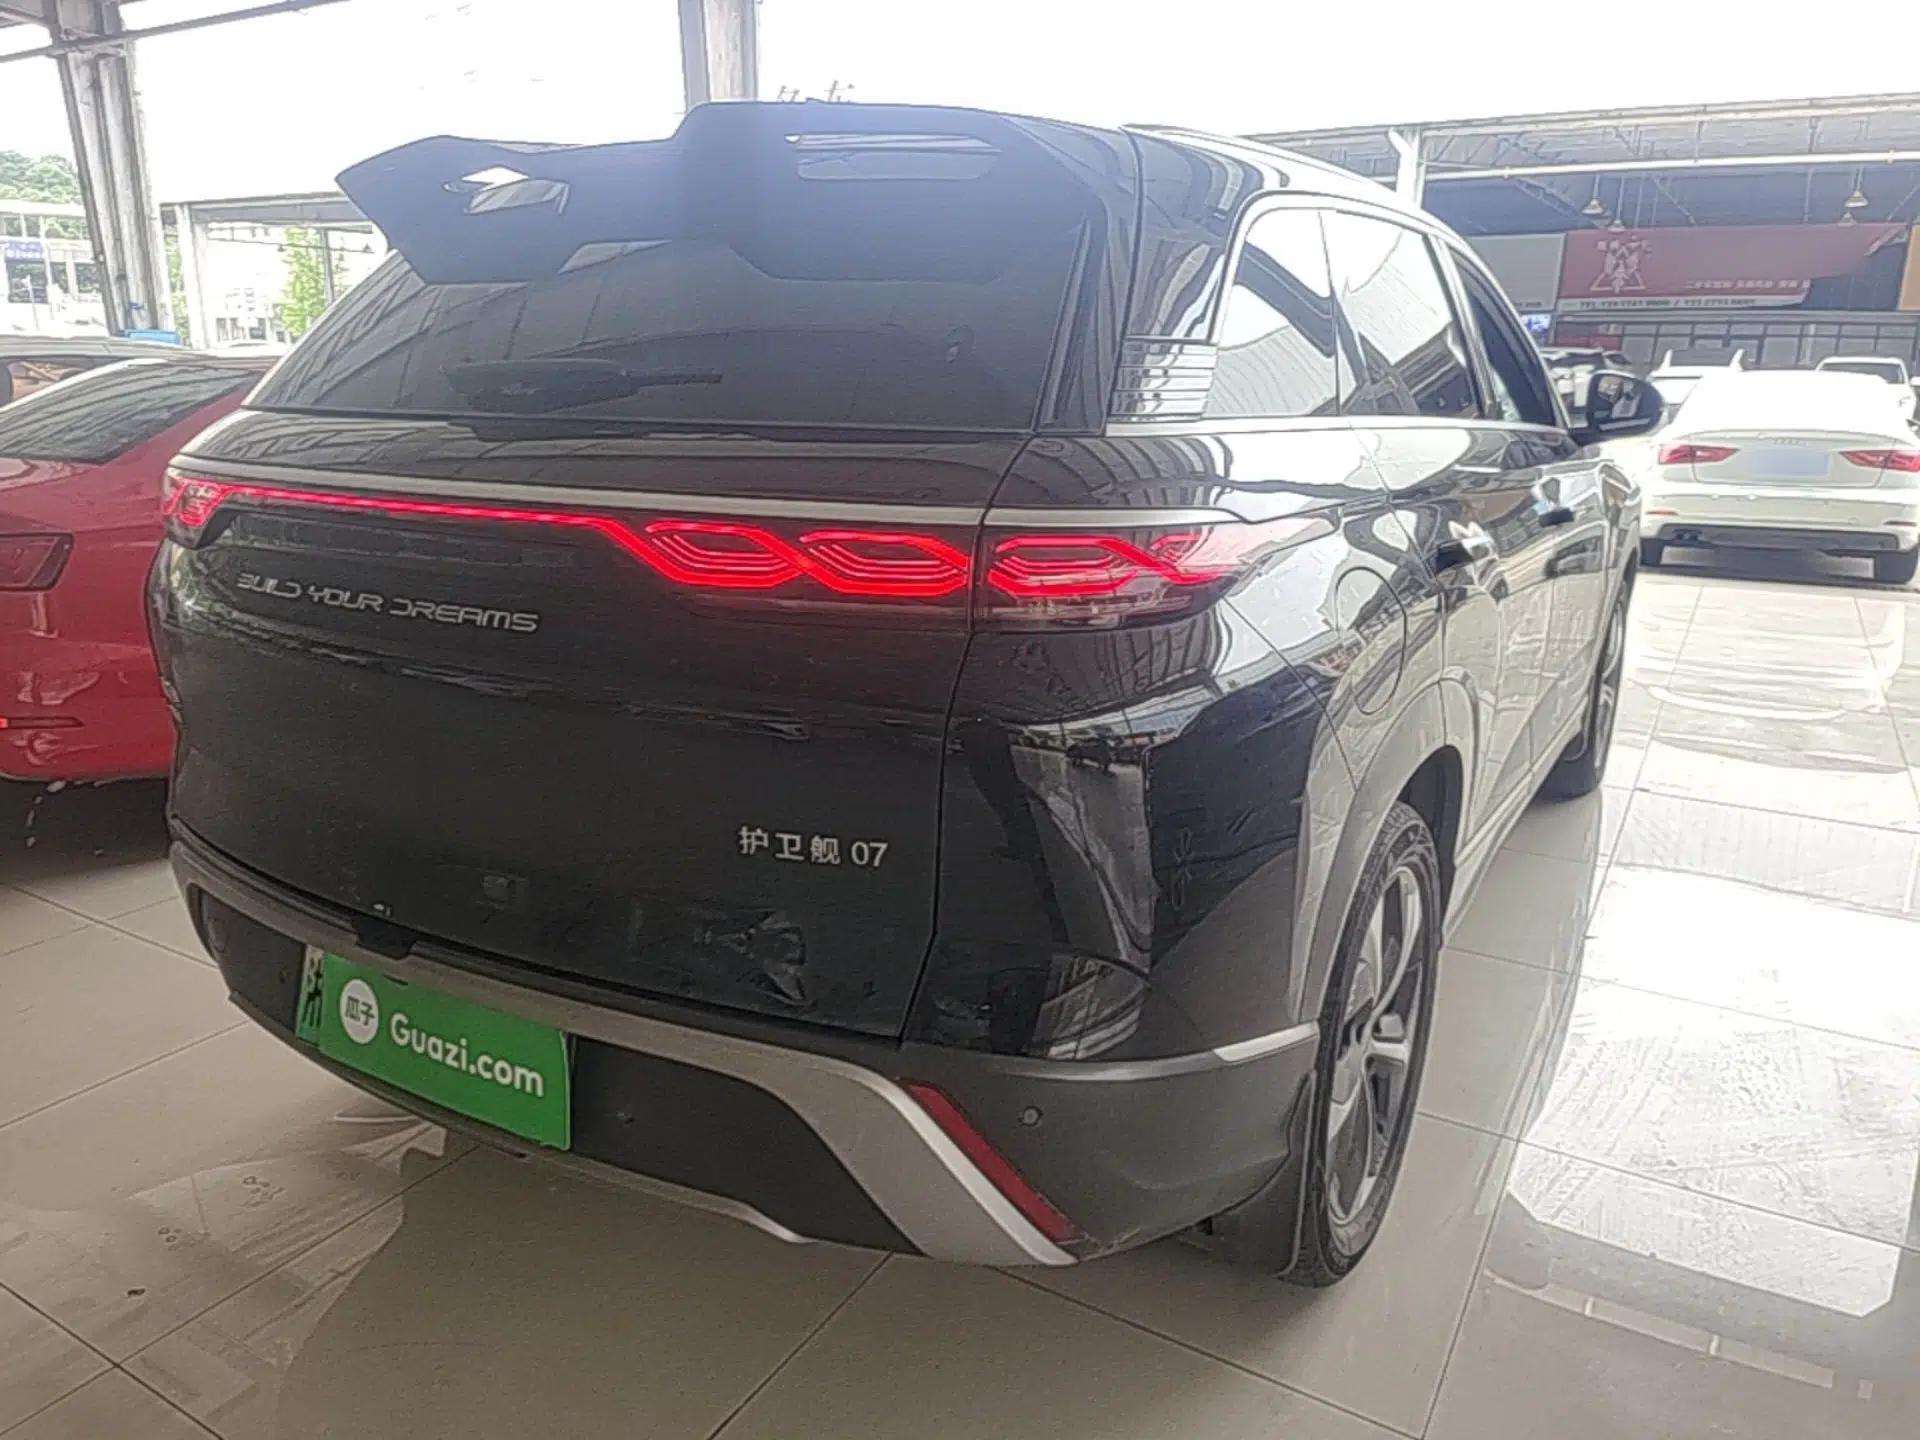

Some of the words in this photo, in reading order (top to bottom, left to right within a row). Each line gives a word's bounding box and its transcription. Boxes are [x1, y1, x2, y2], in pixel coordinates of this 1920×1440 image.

[307, 585, 384, 613] YOUR
[389, 598, 539, 633] DREAMS
[737, 825, 841, 865] 护卫舰
[851, 841, 889, 868] 07
